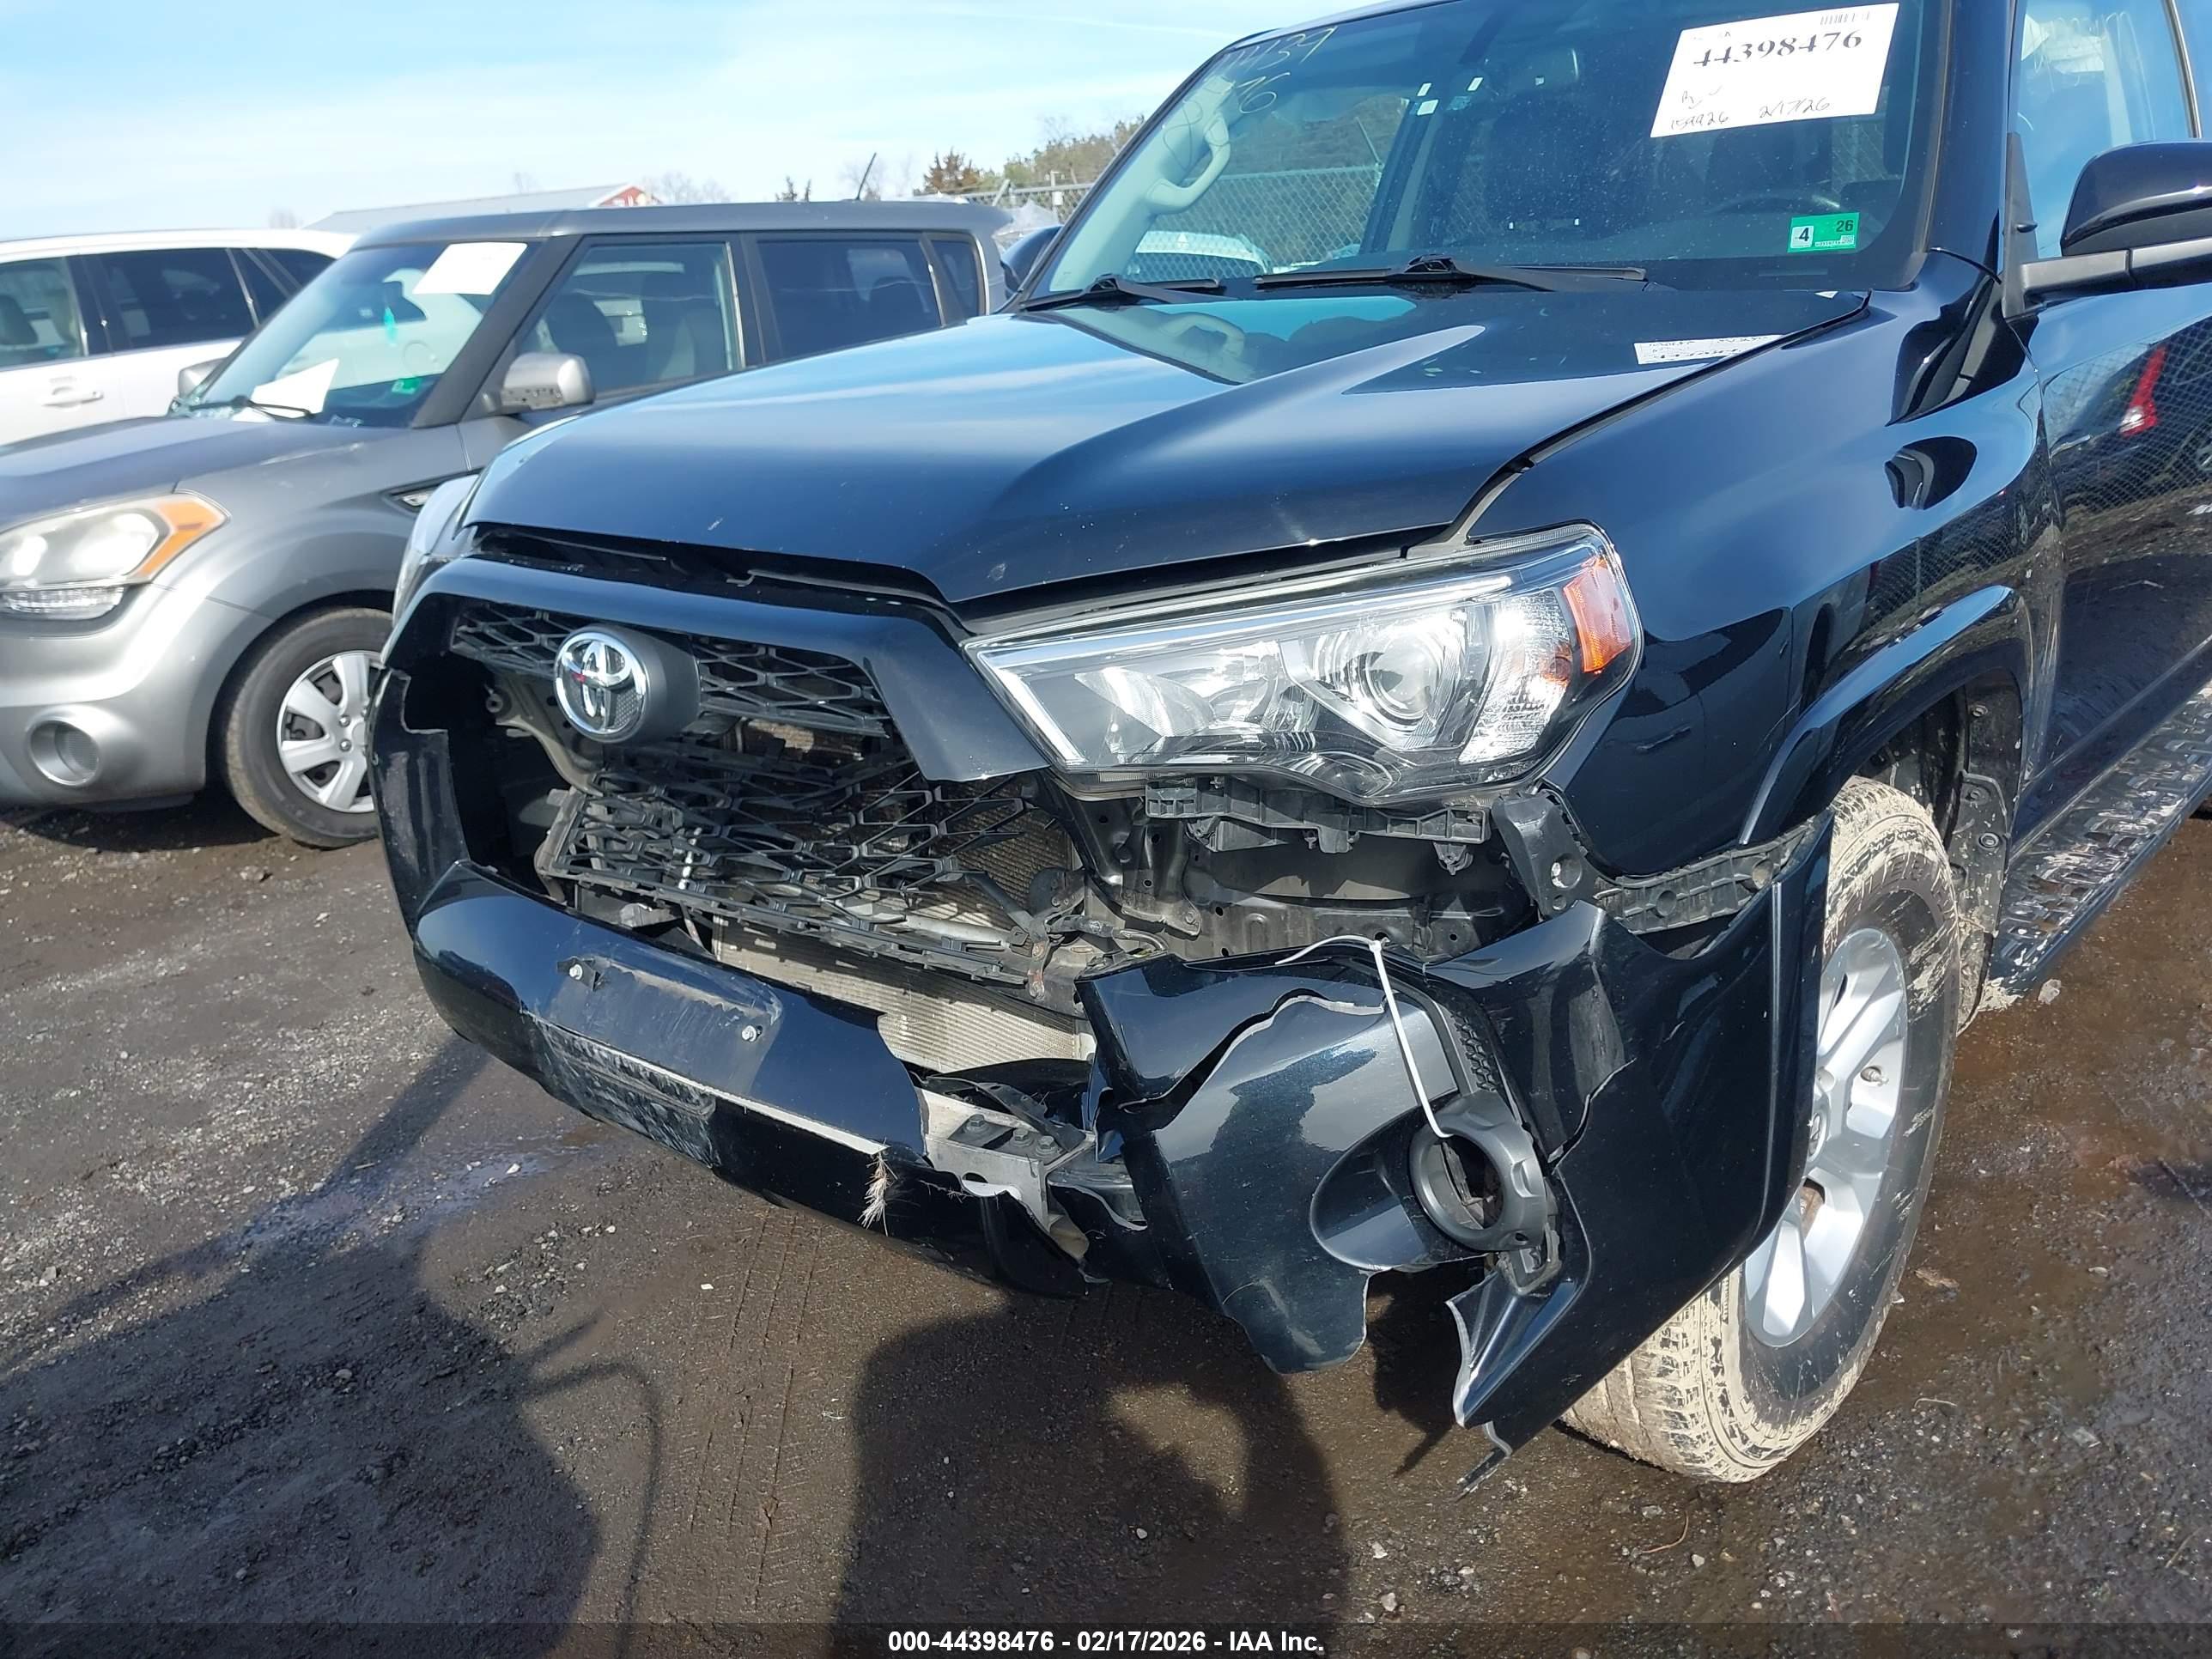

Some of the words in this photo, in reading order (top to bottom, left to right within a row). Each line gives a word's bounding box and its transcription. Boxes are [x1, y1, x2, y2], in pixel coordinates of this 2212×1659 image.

[1693, 30, 1863, 67] 44398476
[1798, 227, 1809, 242] 4
[1836, 219, 1854, 232] 26
